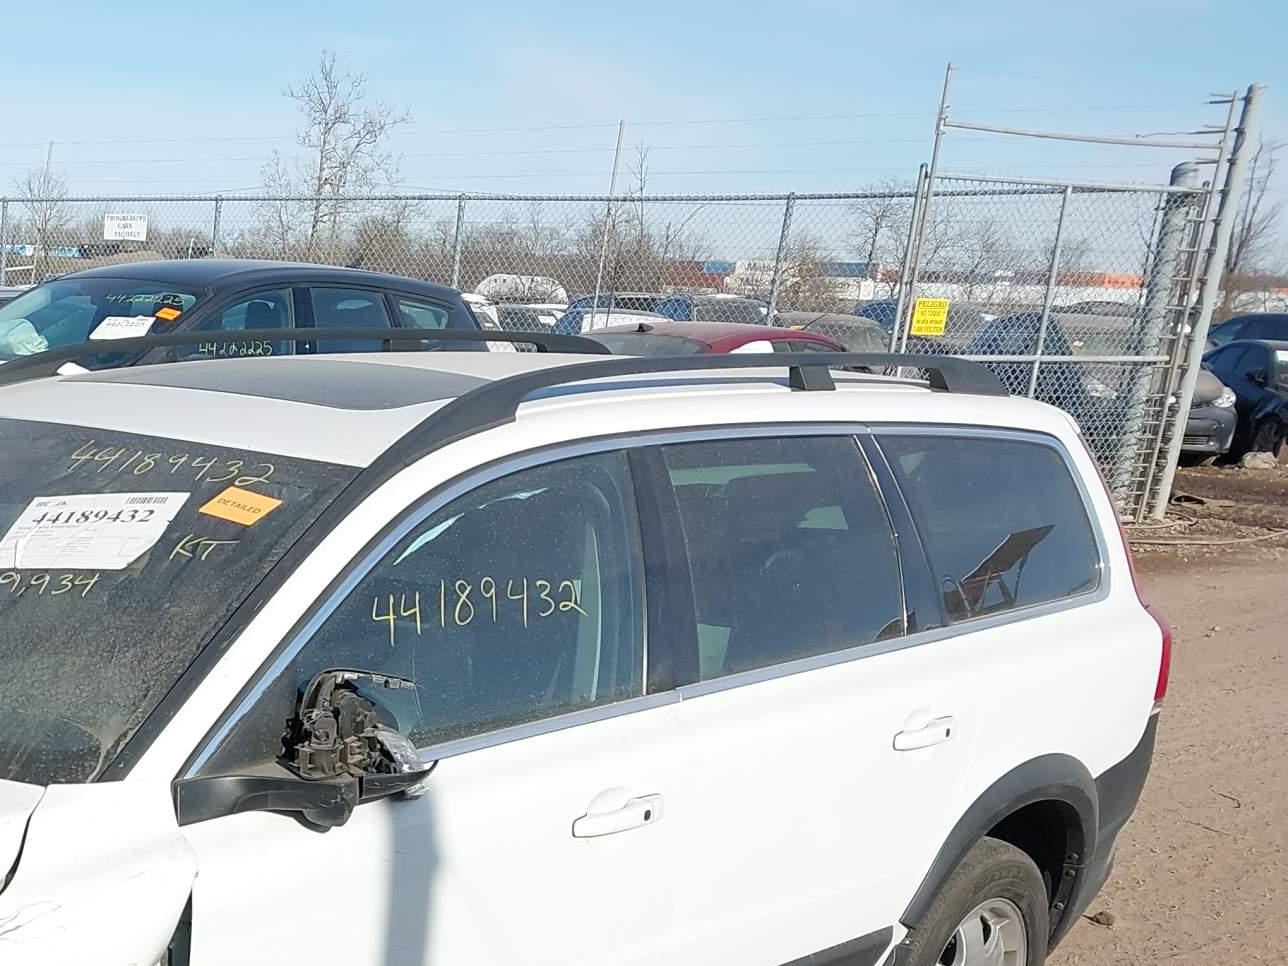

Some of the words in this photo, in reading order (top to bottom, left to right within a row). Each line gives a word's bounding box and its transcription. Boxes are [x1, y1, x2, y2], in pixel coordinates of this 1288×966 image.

[68, 440, 275, 486] 44189432
[32, 509, 156, 525] 44189432
[216, 497, 262, 515] DETAILED
[372, 576, 589, 648] 44189432
